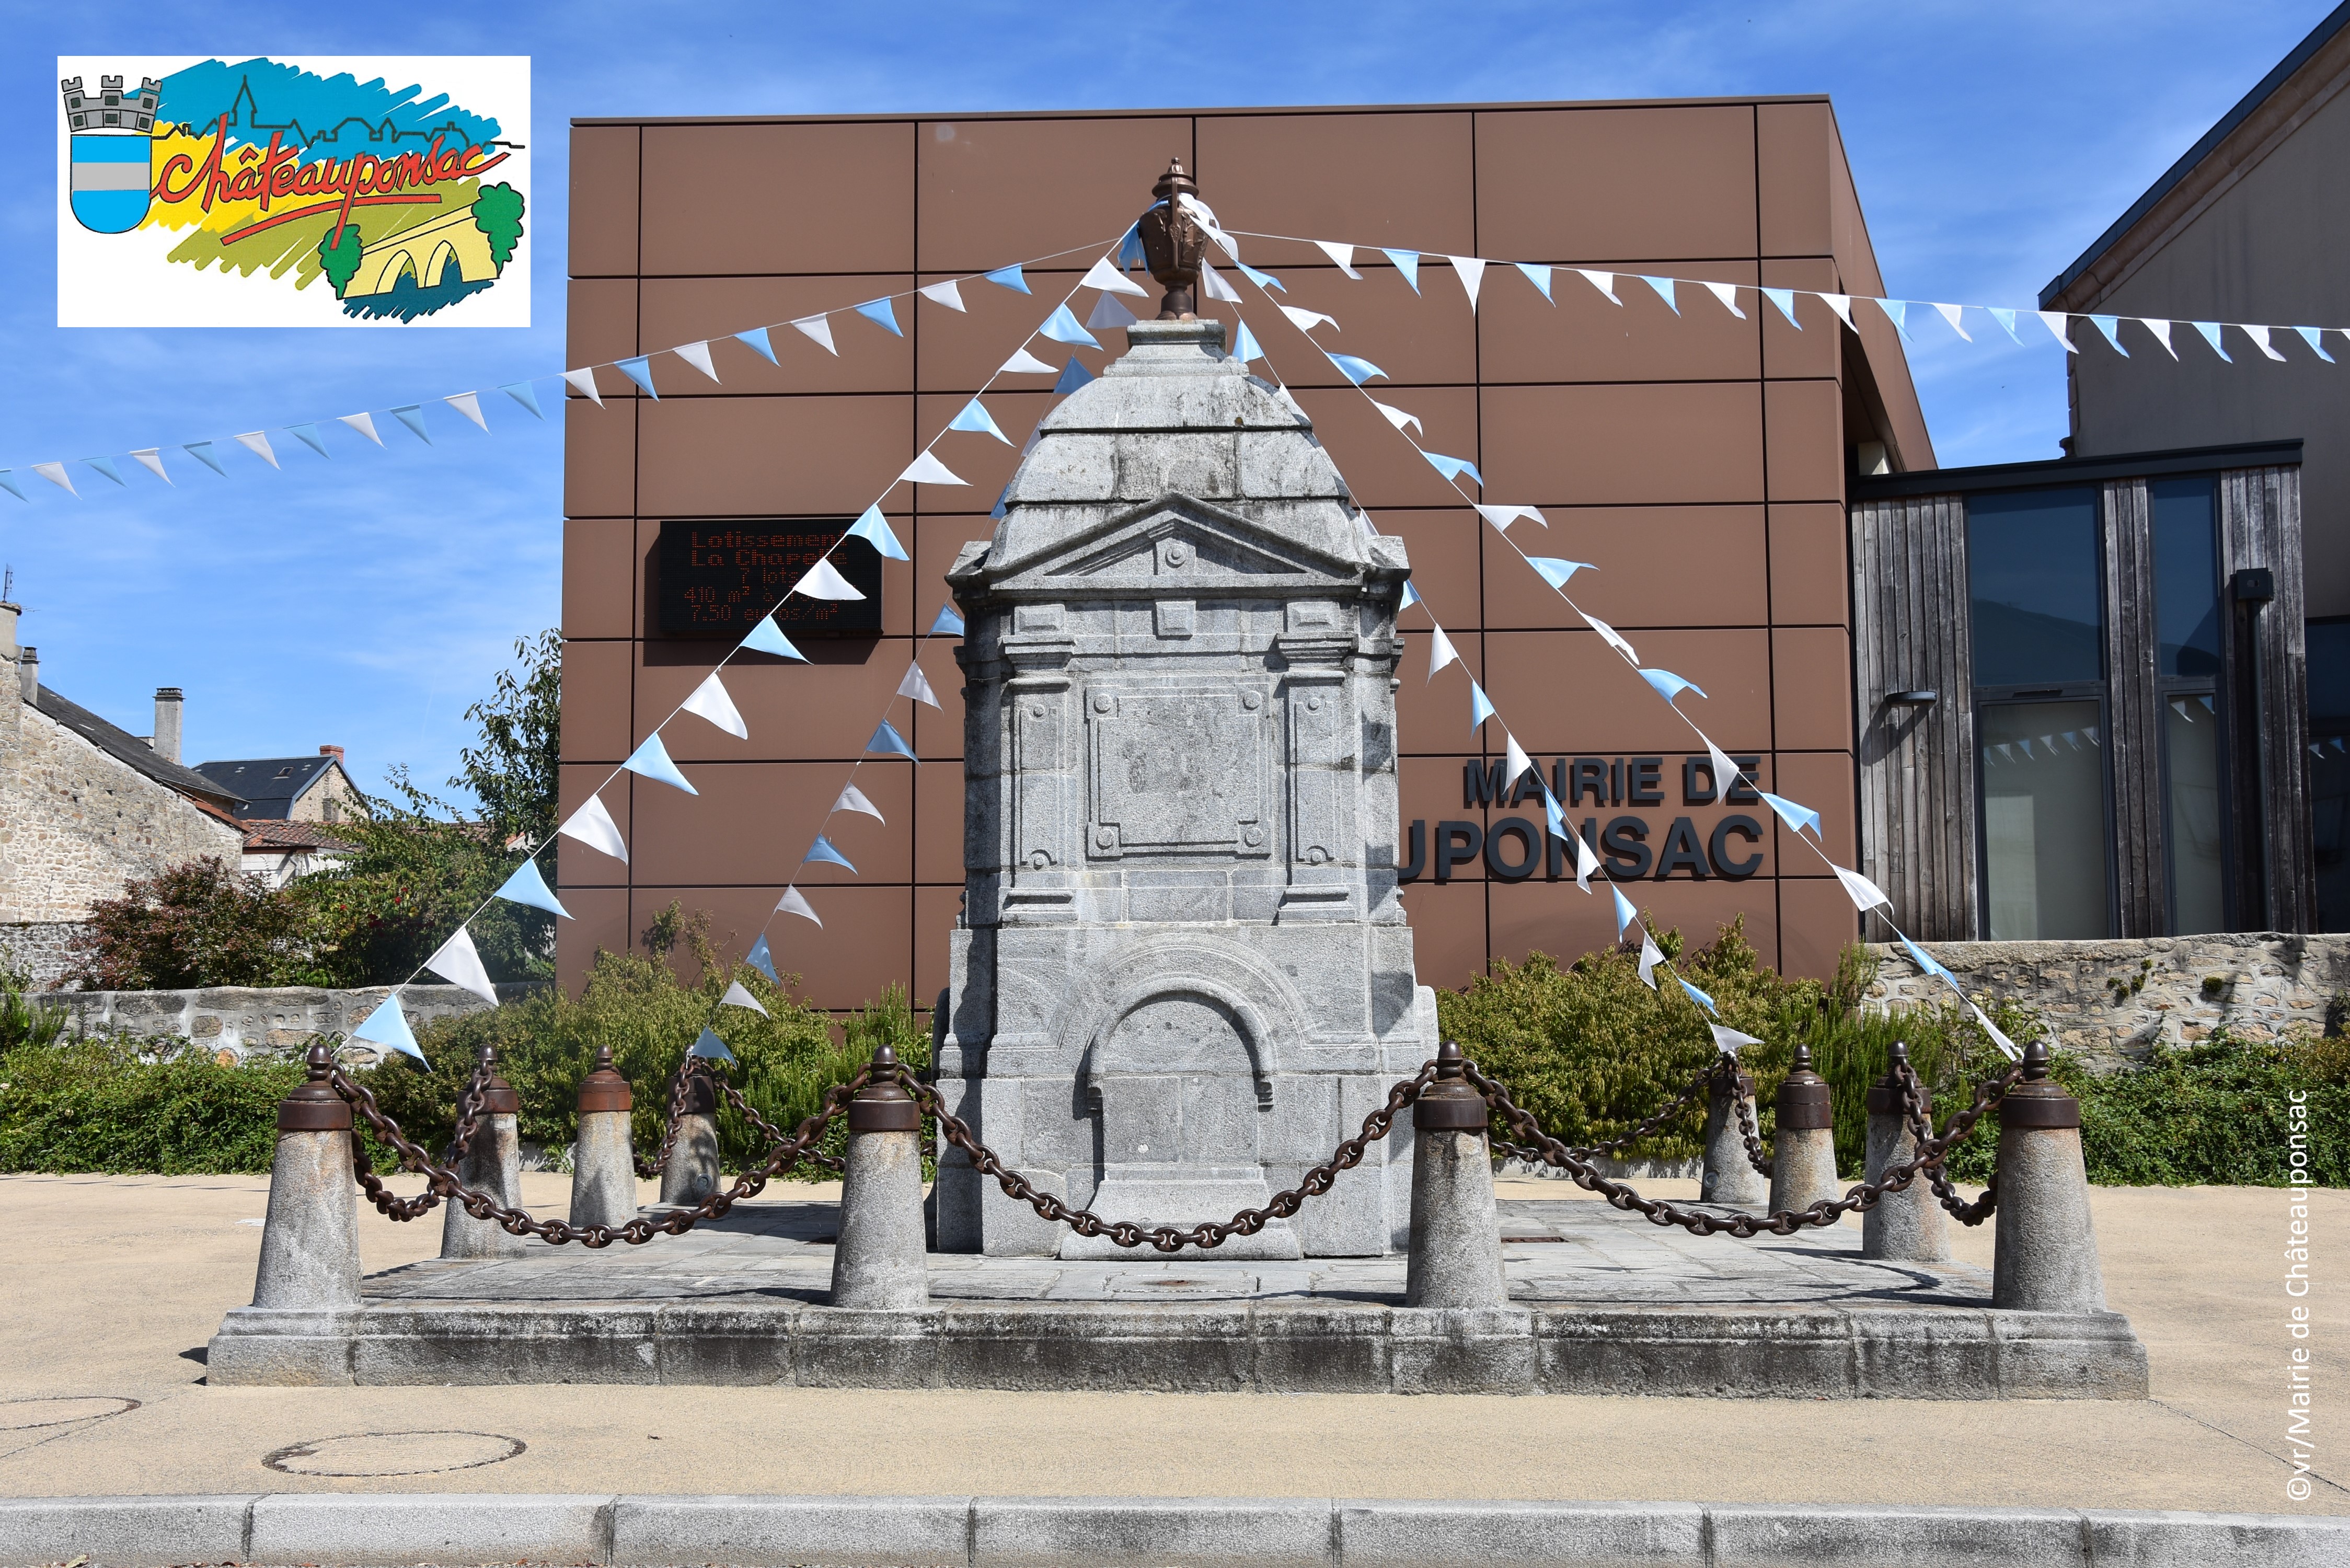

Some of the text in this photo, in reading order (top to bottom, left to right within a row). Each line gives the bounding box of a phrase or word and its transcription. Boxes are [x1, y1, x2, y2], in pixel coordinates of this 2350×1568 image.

[692, 529, 847, 548] Lotissement
[692, 550, 724, 566] La
[740, 568, 798, 584] 7 lots
[684, 586, 716, 603] 410
[691, 605, 731, 621] 7.50
[1467, 756, 1761, 802] MAIRIE DE
